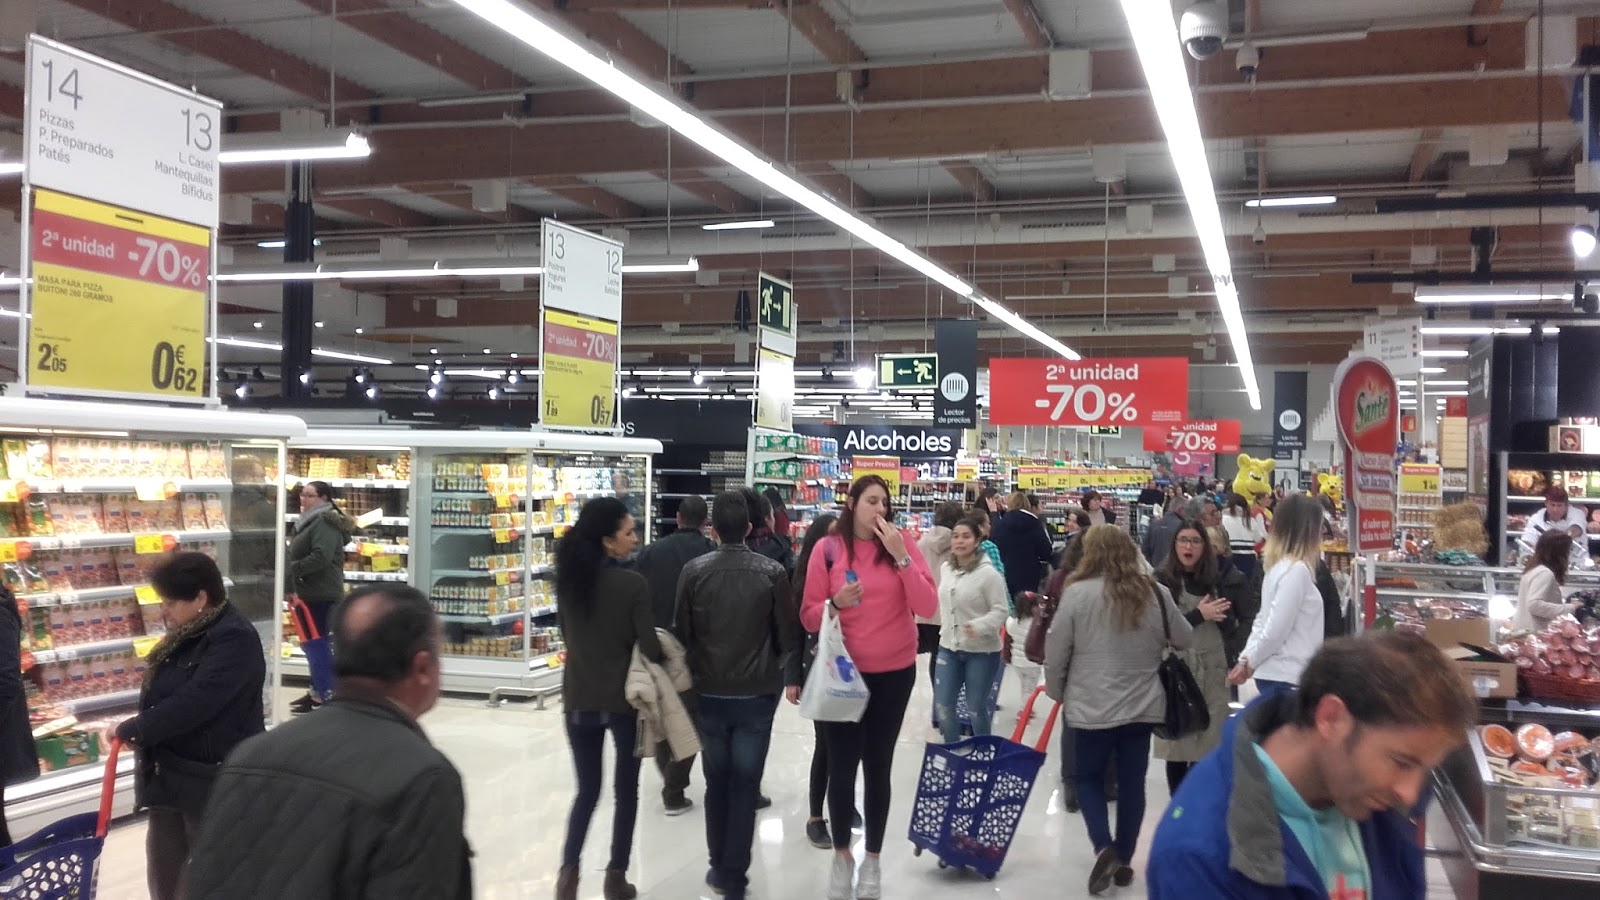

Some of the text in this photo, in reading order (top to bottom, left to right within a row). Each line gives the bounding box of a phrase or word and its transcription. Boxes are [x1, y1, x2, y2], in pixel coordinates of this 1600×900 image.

[41, 59, 83, 110] 14
[39, 108, 75, 130] Pizzas
[181, 108, 212, 152] 13
[38, 143, 70, 164] Patés
[51, 129, 114, 159] Preparados
[154, 160, 213, 187] Mantequillas
[188, 156, 214, 172] Casei
[549, 231, 565, 259] 13
[42, 229, 200, 286] 2ª unidad -70%
[605, 249, 620, 275] 12
[37, 274, 103, 293] MASA PARA PIZZA
[555, 336, 577, 347] unidad
[1046, 364, 1138, 381] 2ª unidad
[943, 408, 965, 416] Lector
[1035, 384, 1137, 421] -70%
[947, 416, 971, 425] precios
[844, 429, 951, 451] Alcoholes
[1166, 432, 1217, 451] -70%
[856, 459, 895, 468] Super Precio
